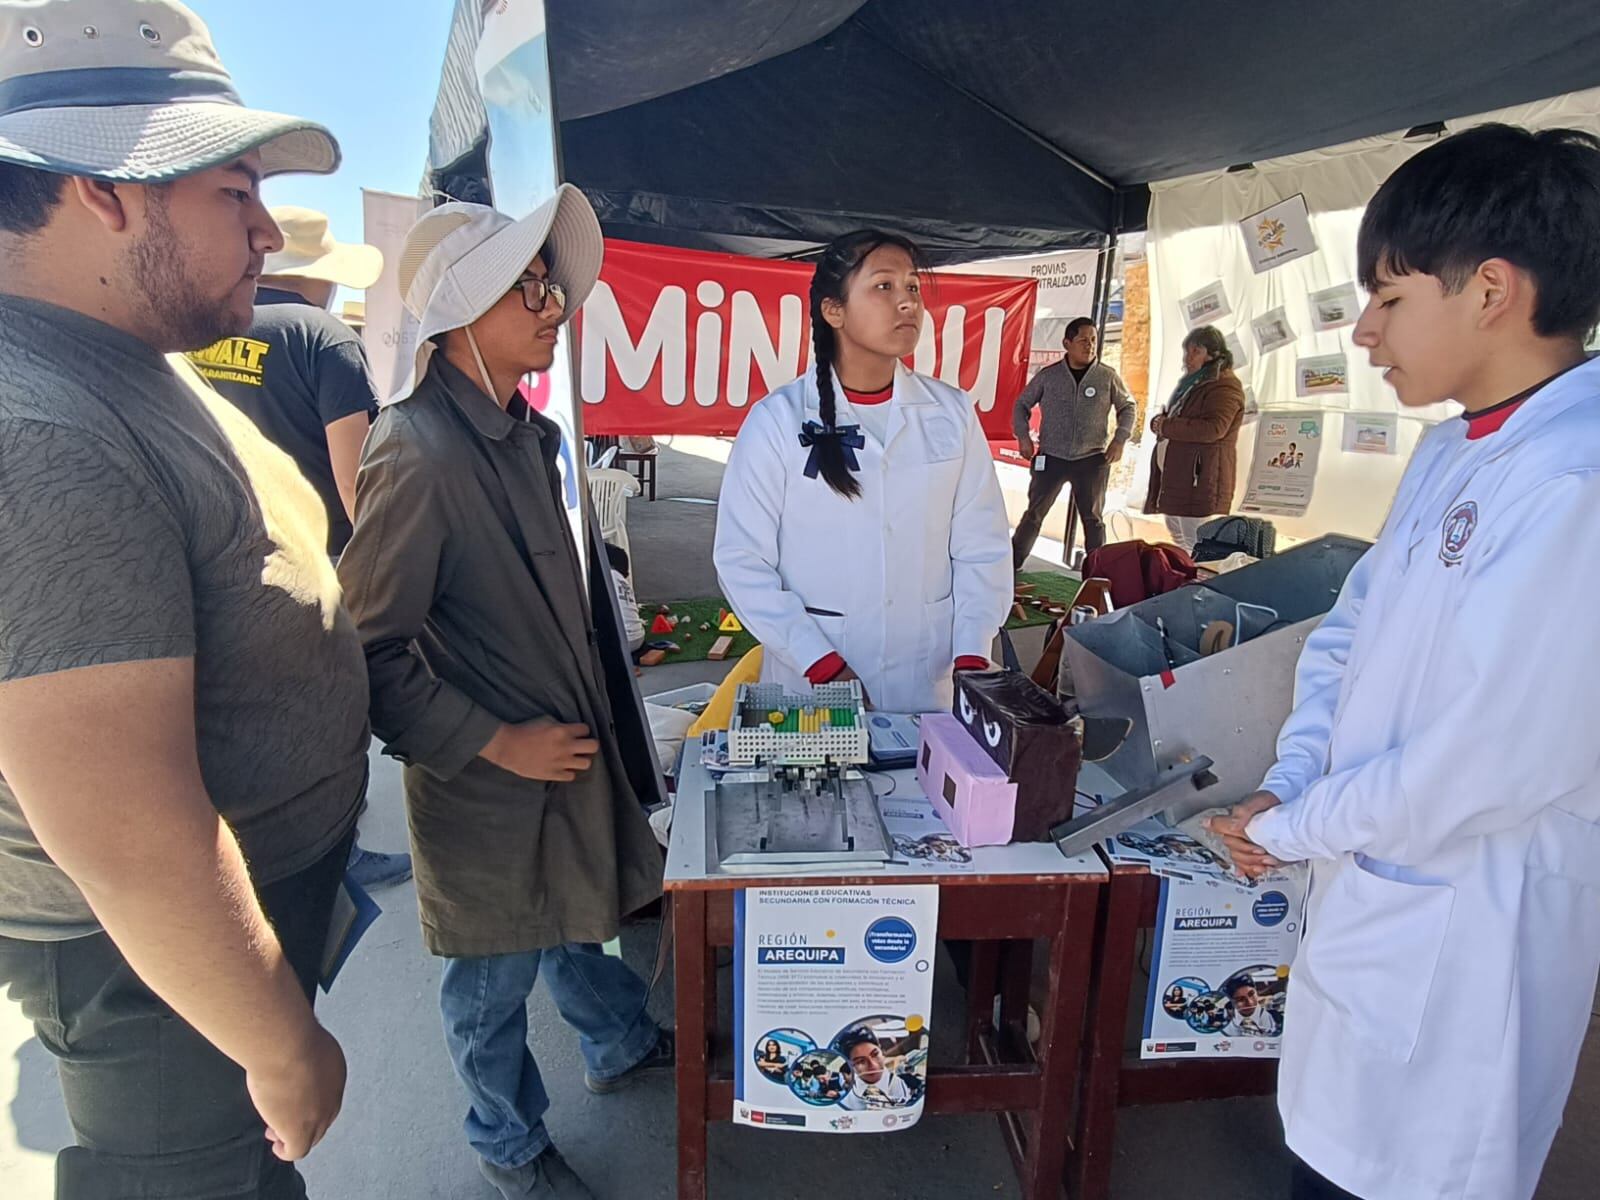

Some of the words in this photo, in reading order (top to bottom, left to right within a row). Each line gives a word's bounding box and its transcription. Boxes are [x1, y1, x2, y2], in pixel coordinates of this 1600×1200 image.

[1031, 262, 1067, 276] PROVIAS
[580, 280, 1006, 412] MiNU
[831, 897, 879, 905] FORMACIÓN
[882, 897, 916, 905] TÉCNICA
[1175, 907, 1212, 917] REGIÓN
[1179, 918, 1233, 928] AREQUIPA
[759, 933, 807, 945] REGIÓN
[764, 950, 839, 961] AREQUIPA
